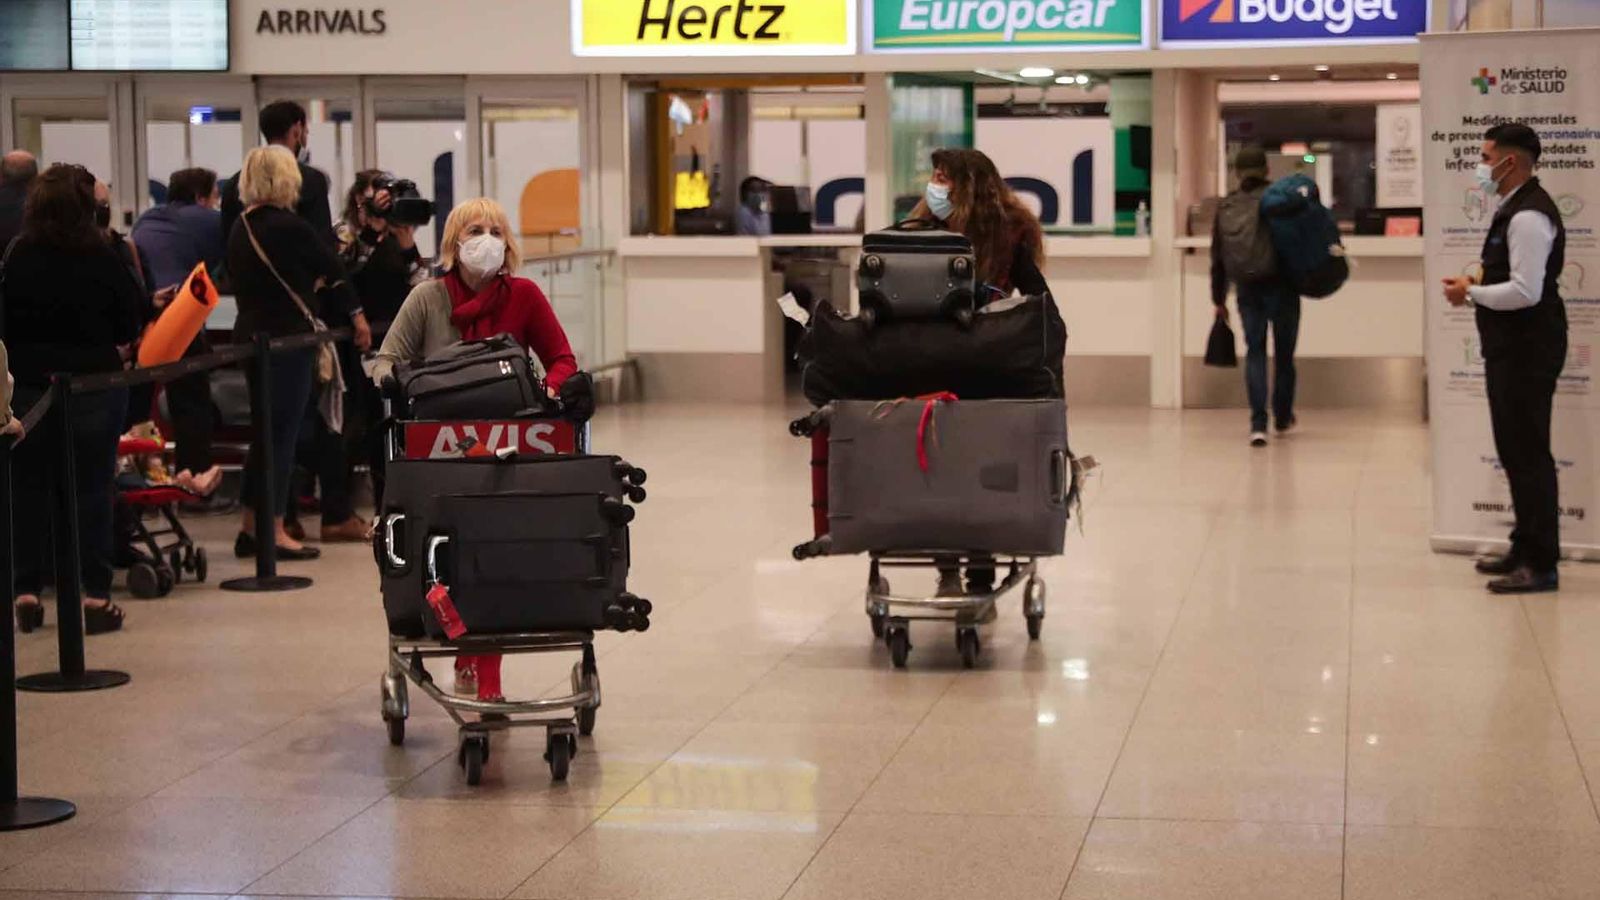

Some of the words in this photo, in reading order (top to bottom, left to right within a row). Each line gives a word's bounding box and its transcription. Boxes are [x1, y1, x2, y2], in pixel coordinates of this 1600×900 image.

[256, 9, 386, 34] ARRIVALS
[636, 0, 786, 41] Hertz
[899, 0, 1117, 43] Europcar
[1501, 66, 1567, 80] Ministerio
[1501, 82, 1518, 94] de
[1520, 81, 1565, 93] SALUD
[1462, 115, 1513, 127] Medidas
[1431, 131, 1446, 141] de
[1453, 147, 1461, 158] y
[428, 422, 556, 460] AVIS
